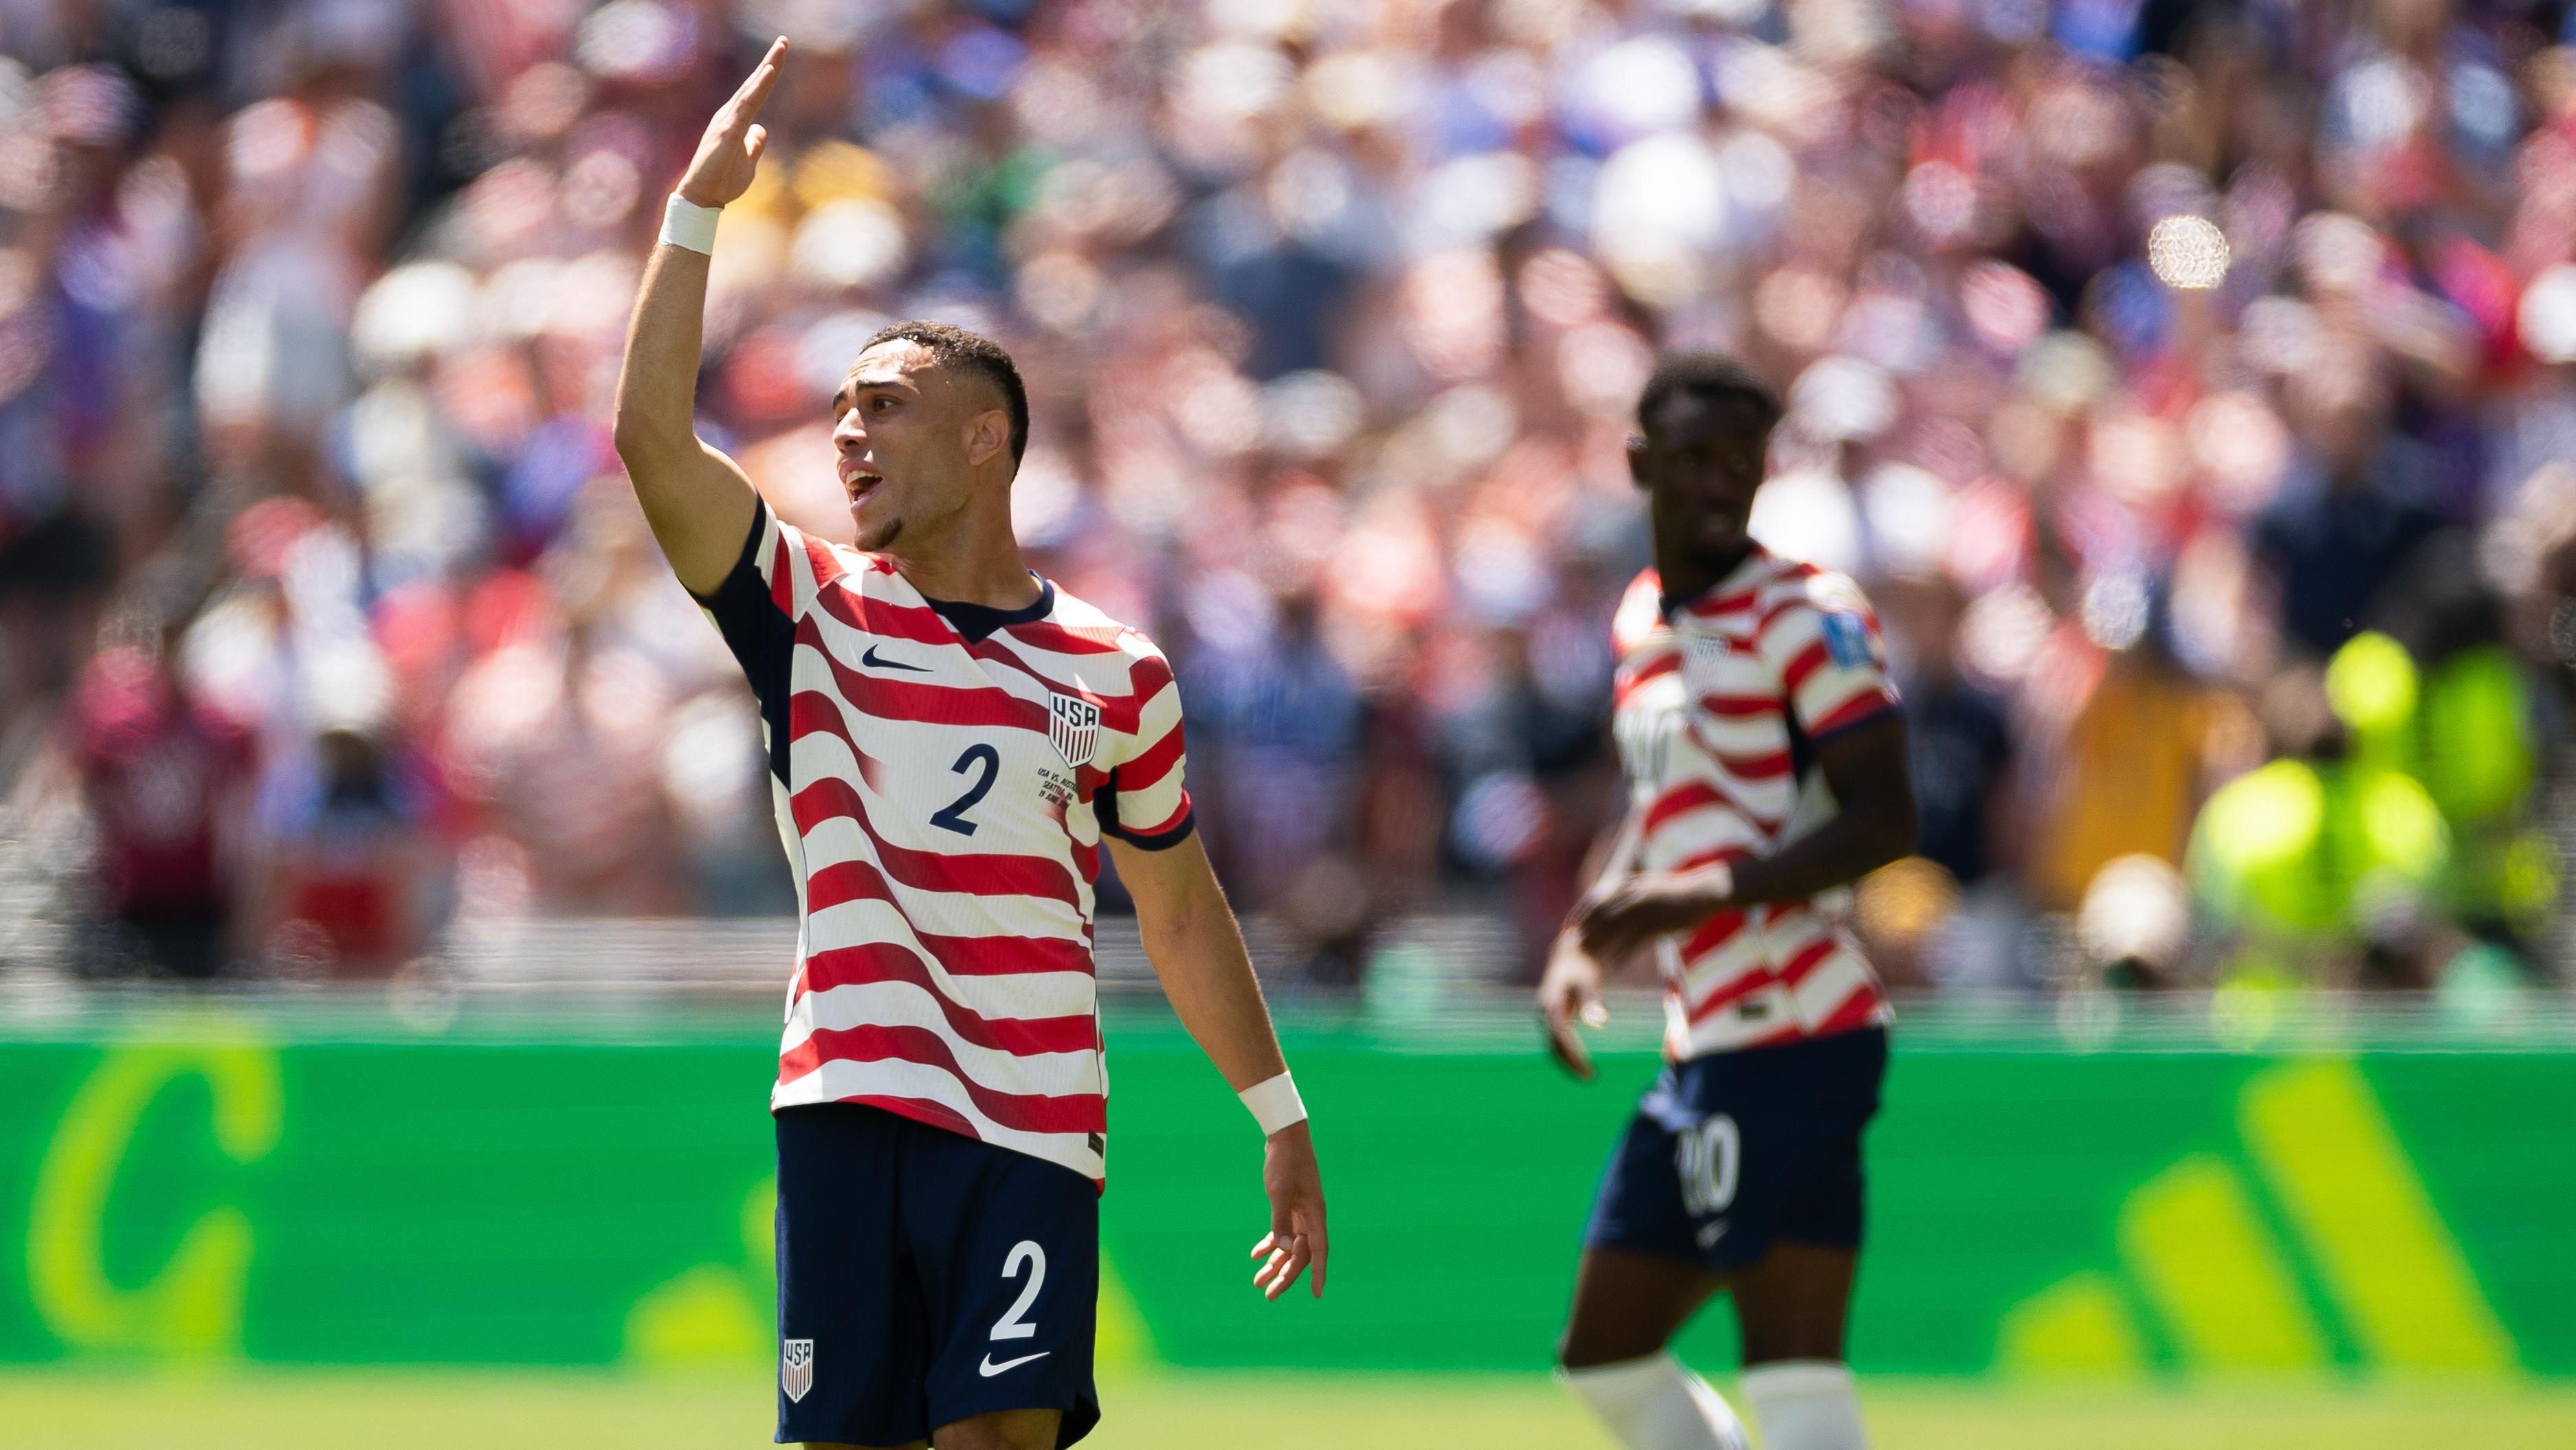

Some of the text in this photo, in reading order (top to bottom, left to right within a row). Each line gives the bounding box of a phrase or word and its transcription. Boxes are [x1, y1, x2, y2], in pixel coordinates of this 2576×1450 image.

[1054, 696, 1096, 727] USA
[1037, 767, 1050, 778] USA
[929, 743, 999, 837] 2
[990, 1240, 1046, 1340] 2
[786, 1343, 811, 1366] USA
